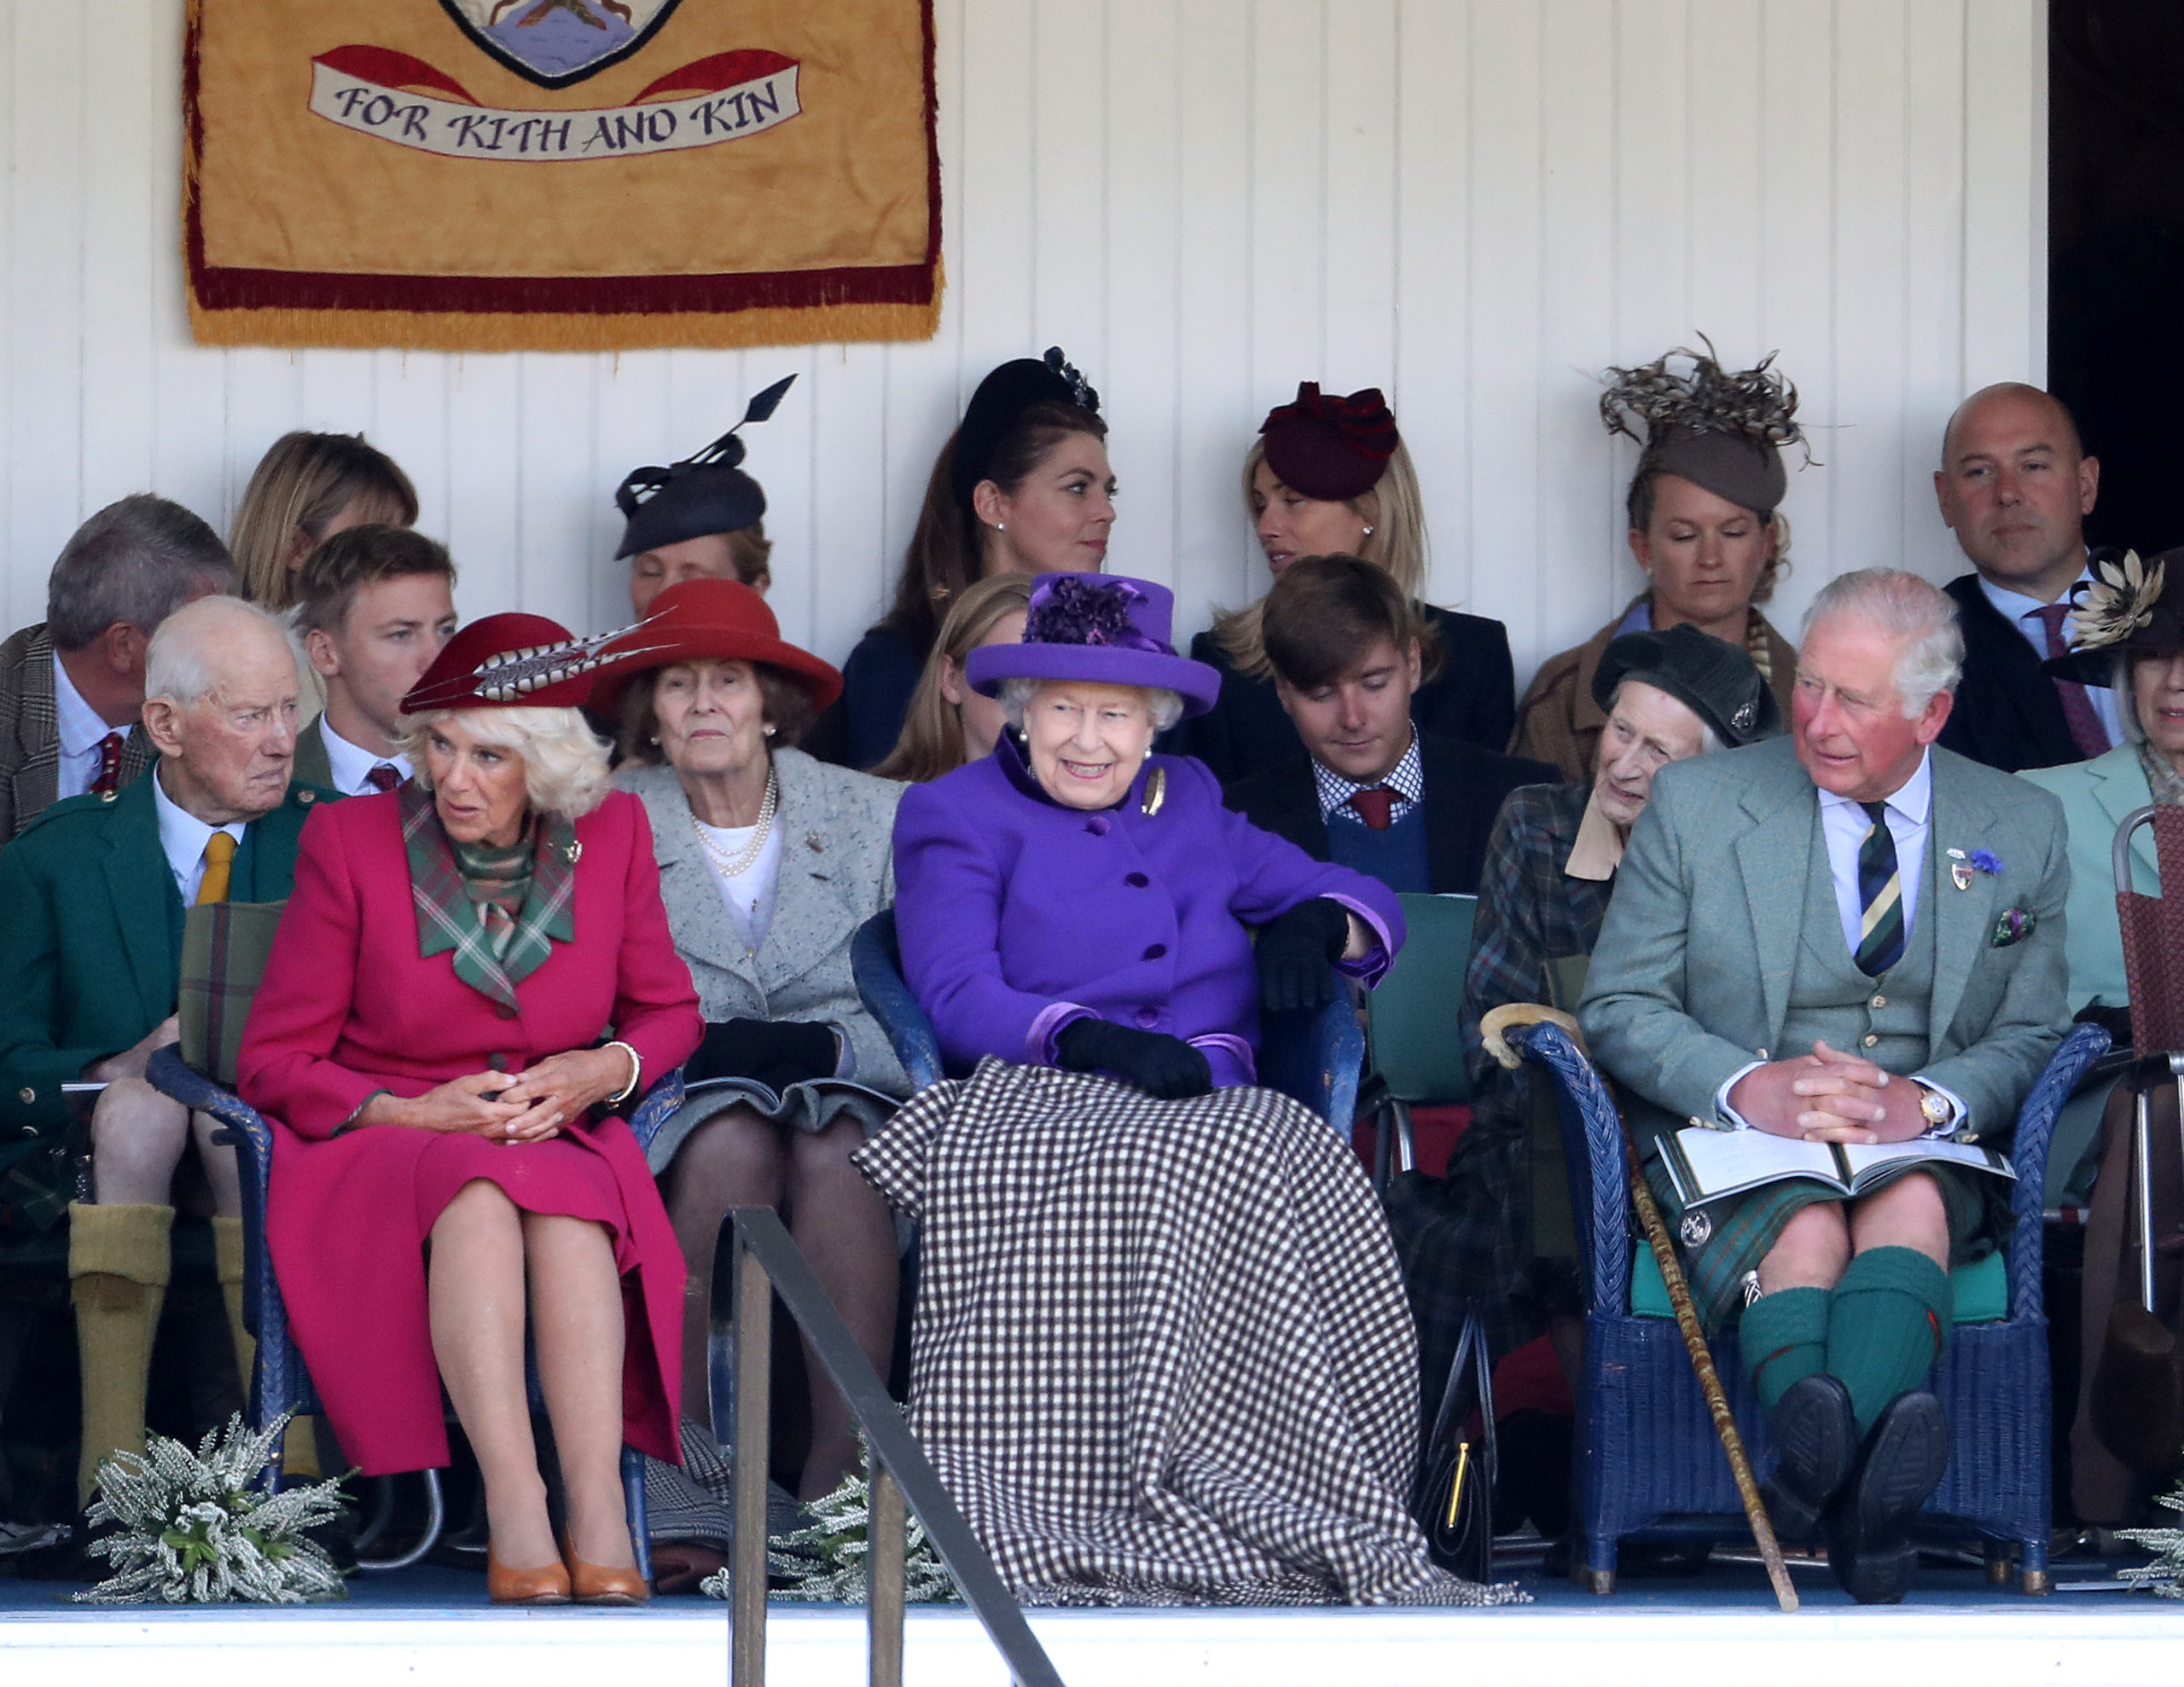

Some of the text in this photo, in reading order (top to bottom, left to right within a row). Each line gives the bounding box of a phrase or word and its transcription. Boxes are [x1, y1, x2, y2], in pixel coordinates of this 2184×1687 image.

[334, 80, 780, 154] FOR KITH AND KIN
